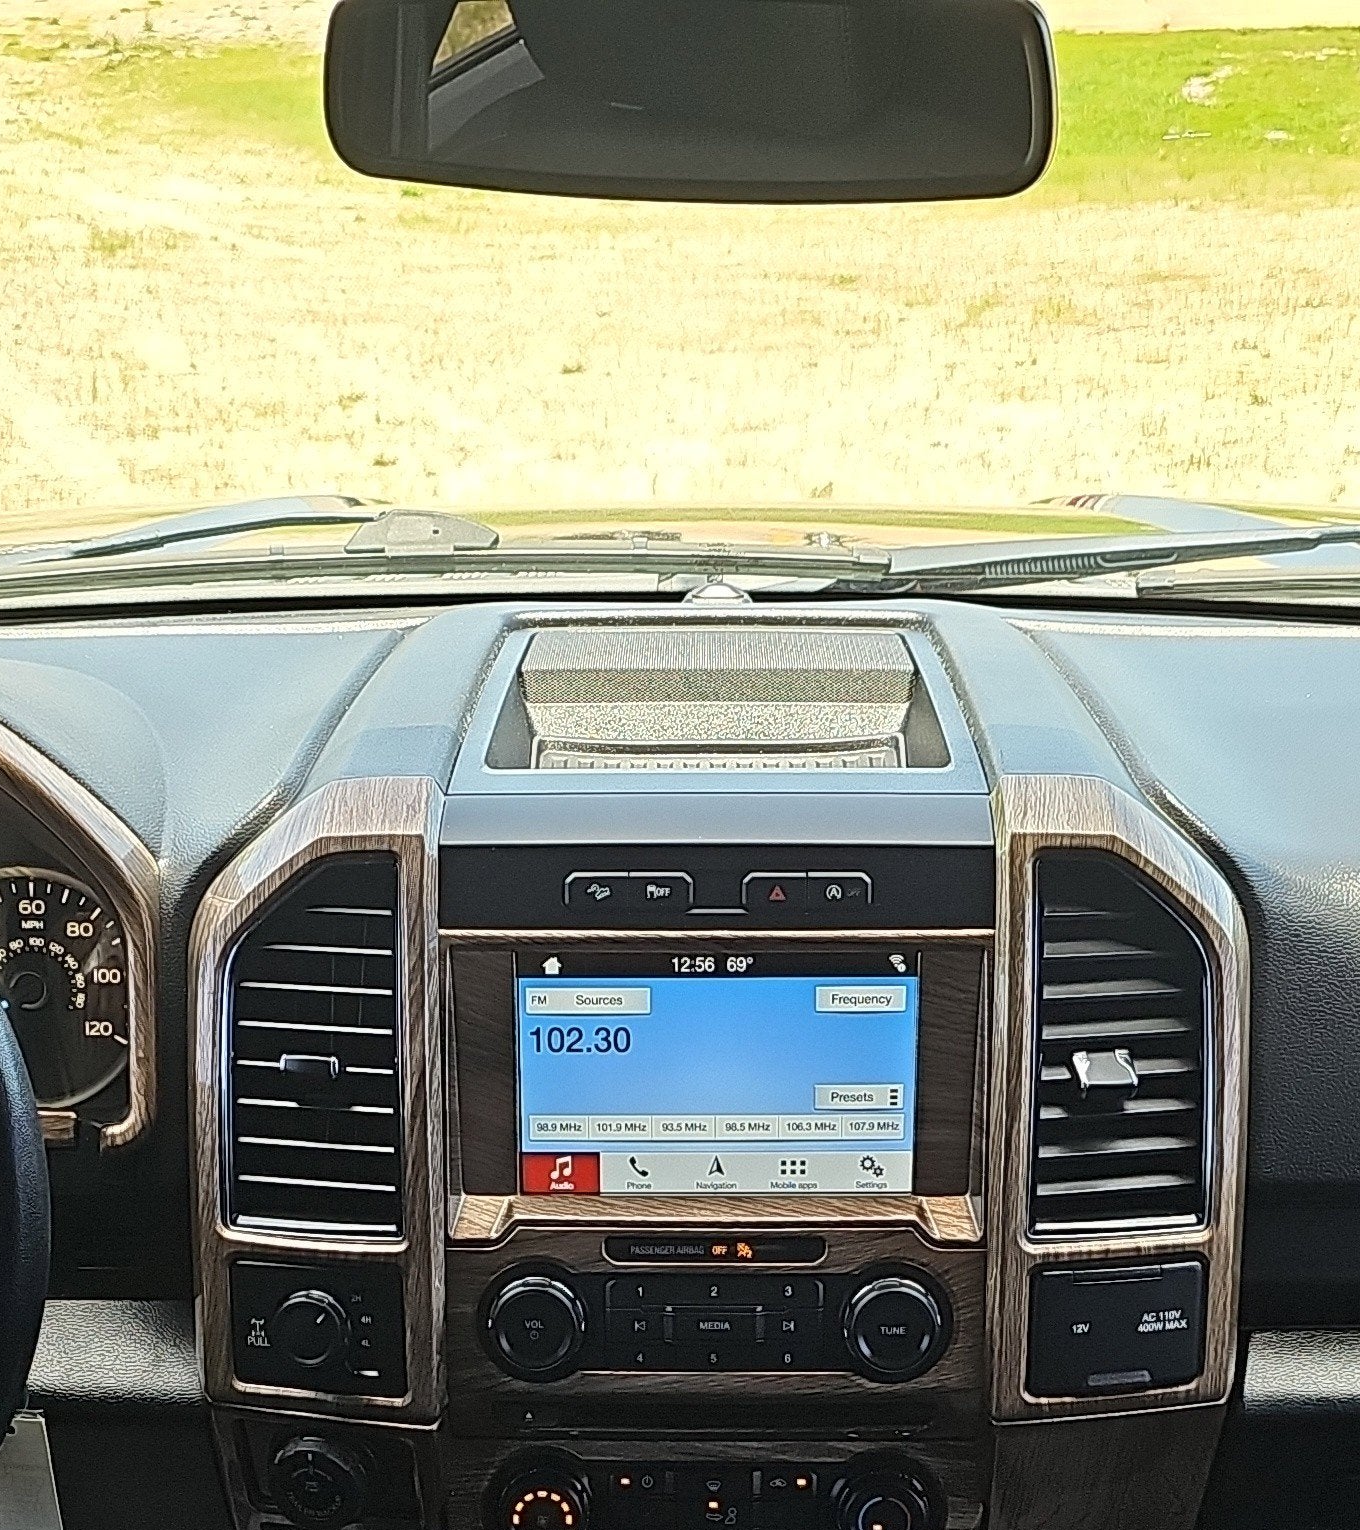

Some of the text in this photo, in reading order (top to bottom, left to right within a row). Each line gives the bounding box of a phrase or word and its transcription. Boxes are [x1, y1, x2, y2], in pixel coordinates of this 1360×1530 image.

[655, 887, 671, 896] OFF
[18, 899, 45, 915] 60
[21, 920, 43, 929] MPH
[66, 922, 93, 937] 80
[671, 956, 754, 973] 12:56 69°
[93, 968, 120, 984] 100
[531, 994, 623, 1007] FM Sources
[830, 993, 893, 1009] Frequency
[85, 1020, 113, 1036] 120
[529, 1026, 631, 1053] 102.30
[830, 1092, 874, 1104] Presets
[536, 1122, 582, 1132] 98.9 MHz
[596, 1122, 647, 1132] 101.9 MHz
[662, 1122, 707, 1132] 93.5 MHz
[725, 1122, 770, 1131] 98.5 MHz
[786, 1122, 837, 1131] 106.3 MHz
[849, 1121, 900, 1131] 107.9 MHz
[550, 1181, 575, 1191] Audio
[626, 1181, 652, 1190] Phone
[696, 1181, 737, 1191] Navigation
[770, 1181, 818, 1191] Mobile apps
[855, 1181, 888, 1190] Settings
[630, 1245, 728, 1255] PASSENGER AIRBAG OFF
[637, 1286, 793, 1297] 1 2 3
[1141, 1309, 1182, 1323] AC 110V
[524, 1319, 545, 1329] VOL
[699, 1321, 731, 1330] MEDIA
[1072, 1323, 1090, 1334] 12V
[1137, 1318, 1188, 1333] 400W MAX
[879, 1326, 908, 1335] TUNE
[247, 1336, 270, 1347] PULL
[636, 1353, 791, 1363] 4 5 6
